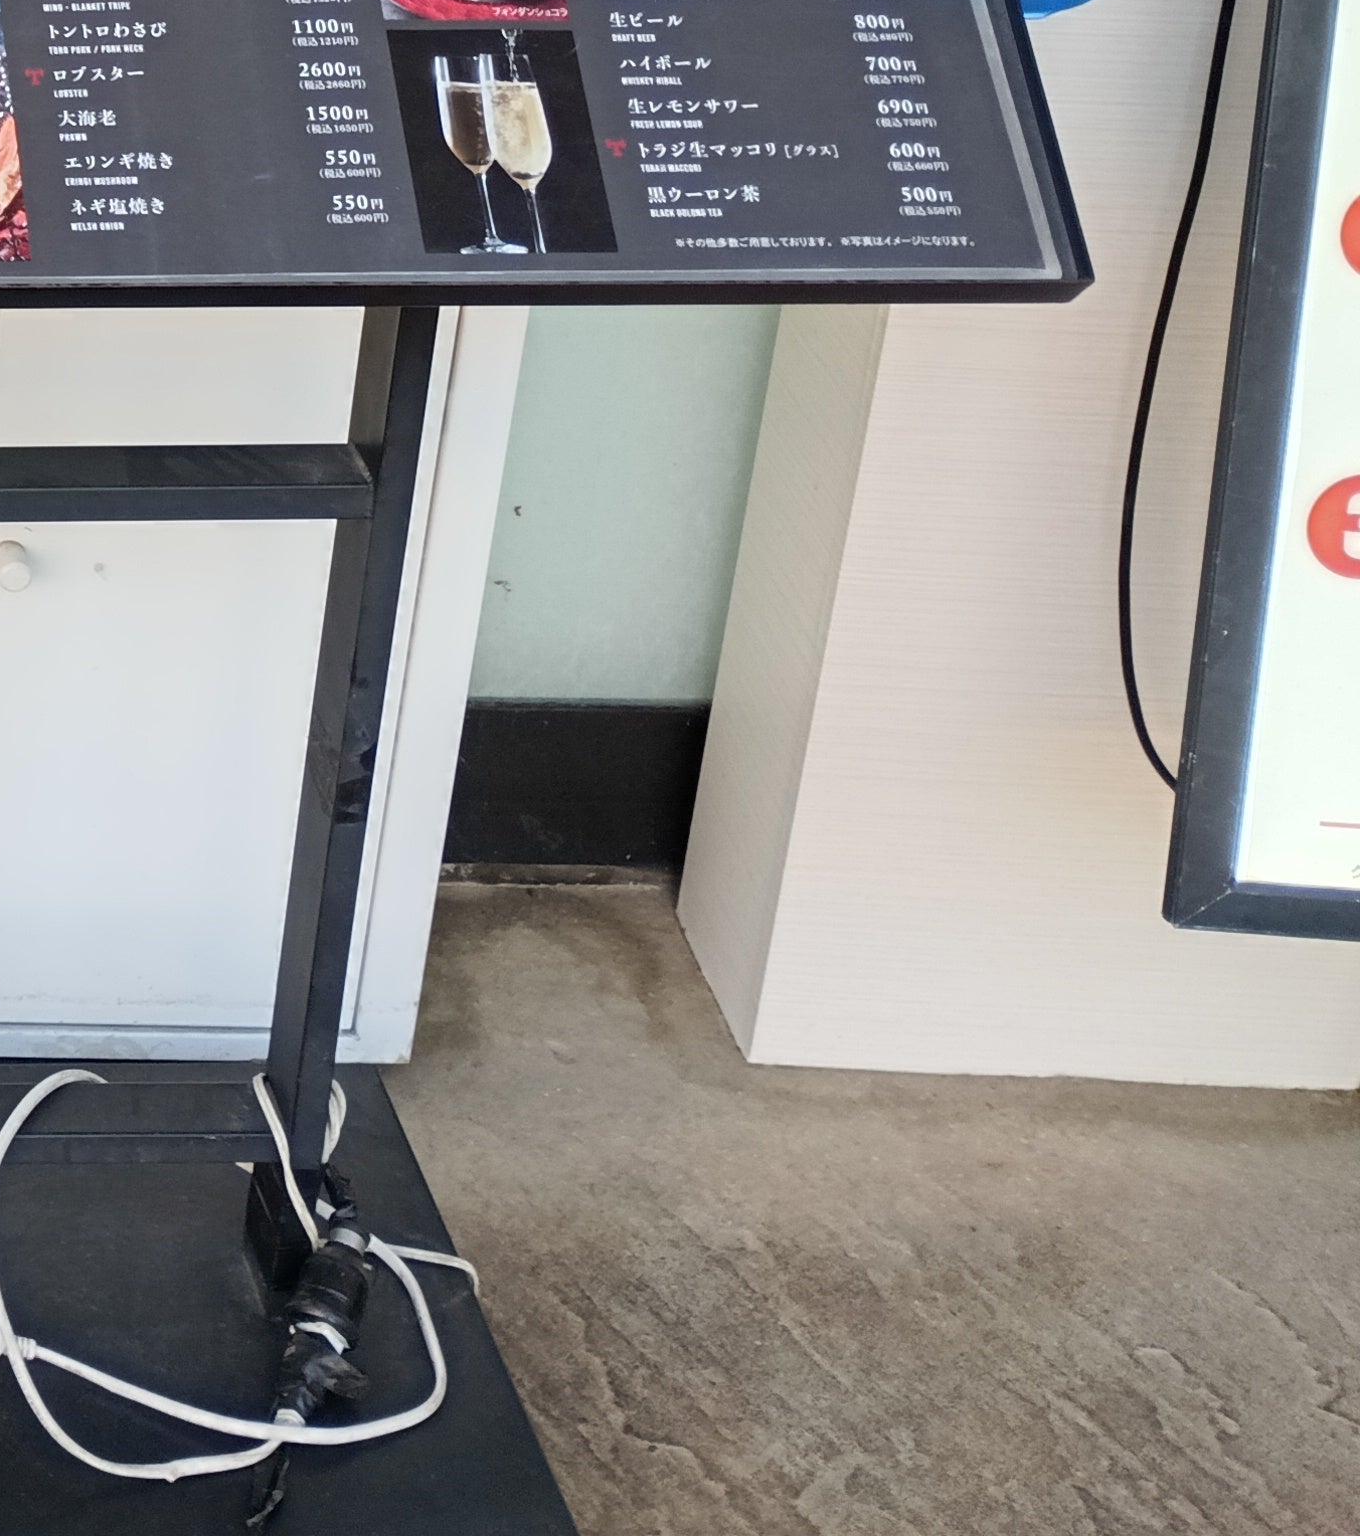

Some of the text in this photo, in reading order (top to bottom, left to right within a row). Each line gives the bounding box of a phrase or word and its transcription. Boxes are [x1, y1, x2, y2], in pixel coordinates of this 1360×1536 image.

[609, 11, 683, 28] 生ビール
[853, 14, 905, 30] 800円
[48, 21, 167, 39] トントロわさび
[298, 61, 361, 78] 2600円
[619, 54, 712, 71] ハイボール
[53, 65, 145, 82] ロブスター
[627, 97, 759, 115] 生レモンサワー
[877, 98, 929, 115] 690円
[58, 108, 117, 127] 大海老
[64, 152, 173, 170] エリンギ焼き
[325, 149, 376, 166] 550円
[647, 184, 760, 204] 黒ウーロン茶
[901, 186, 953, 203] 500円
[71, 196, 165, 216] ネギ塩焼き
